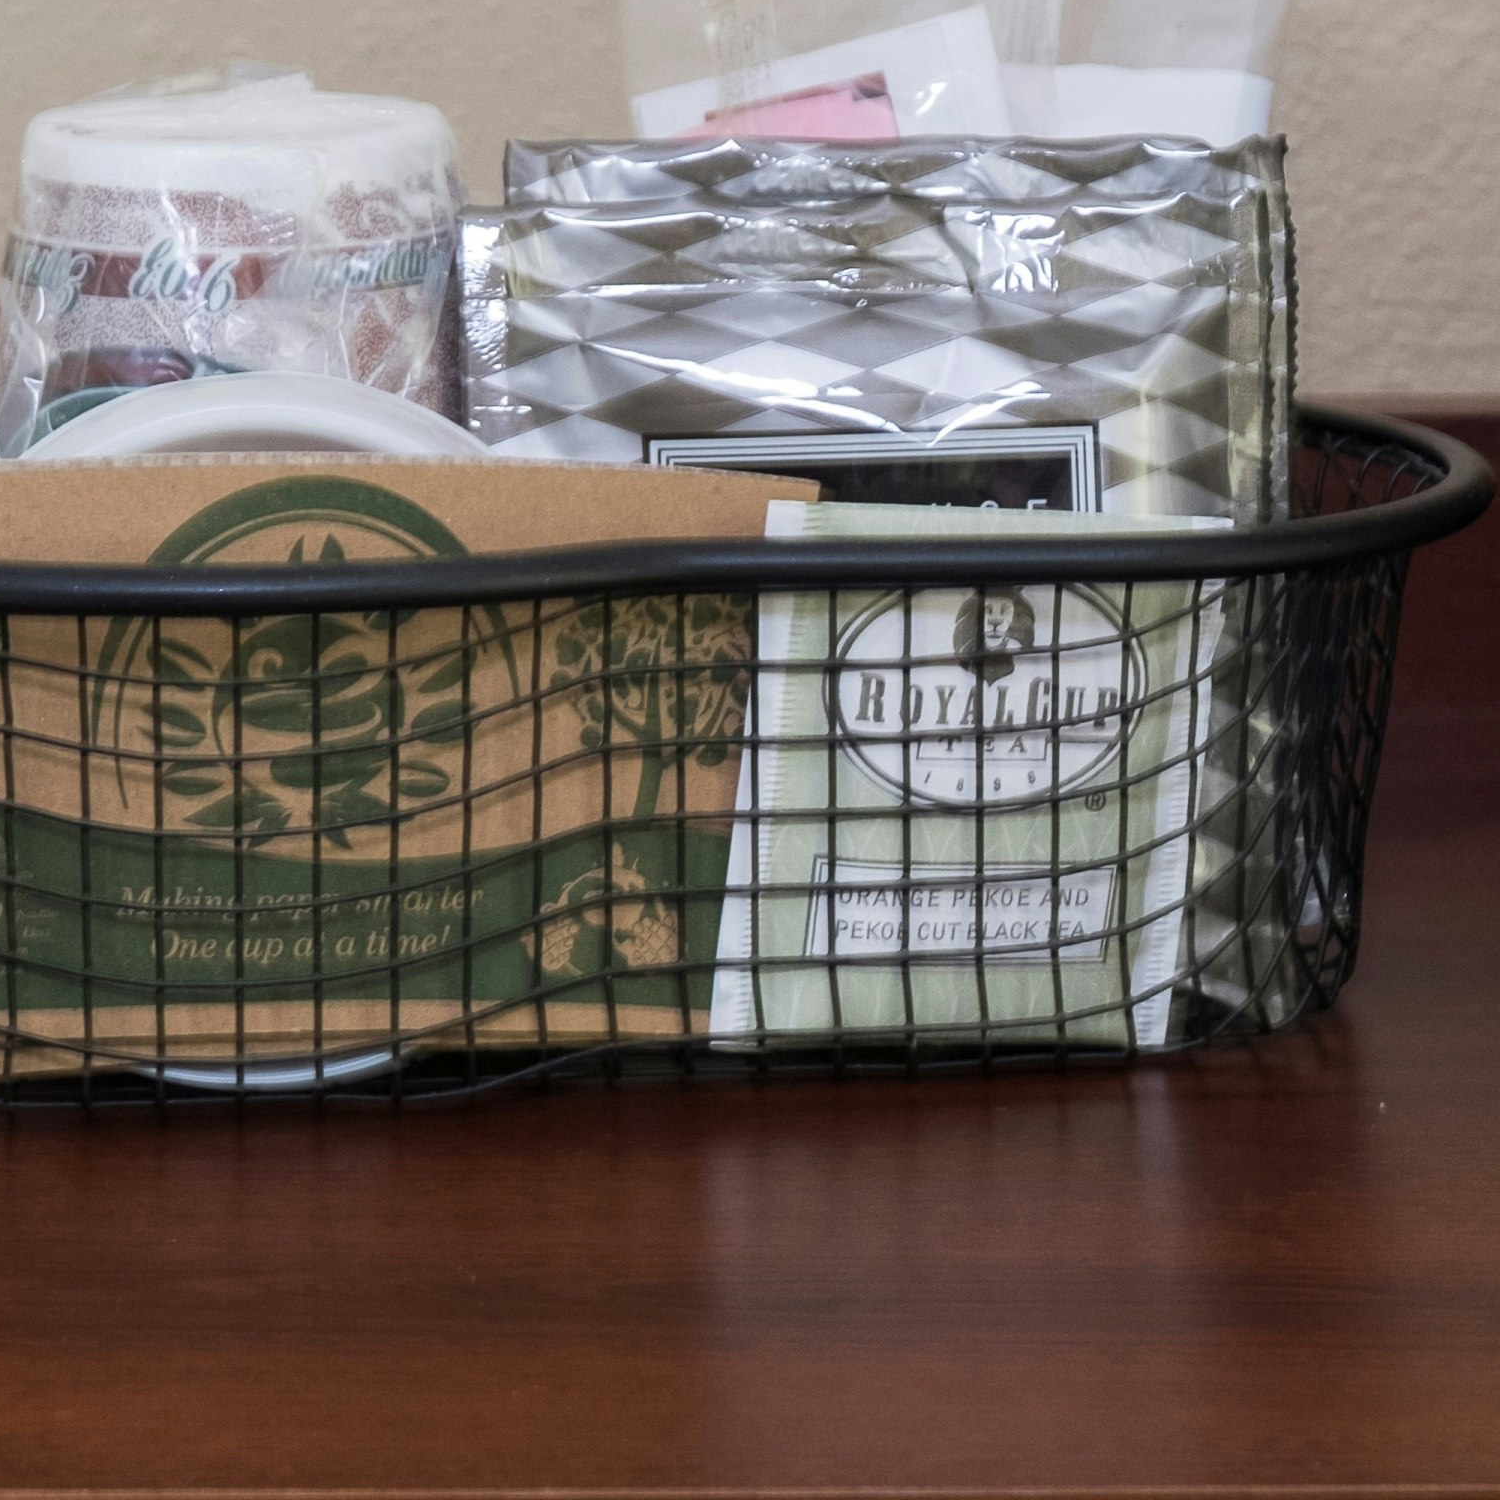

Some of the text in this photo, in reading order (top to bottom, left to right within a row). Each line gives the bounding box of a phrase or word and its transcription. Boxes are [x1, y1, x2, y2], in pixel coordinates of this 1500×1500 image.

[938, 734, 1027, 753] TEA
[838, 887, 1090, 908] ORANGE PEKOE AND
[835, 919, 905, 941] PEKOE
[917, 921, 962, 941] CUT
[151, 923, 450, 965] One cup a a time!
